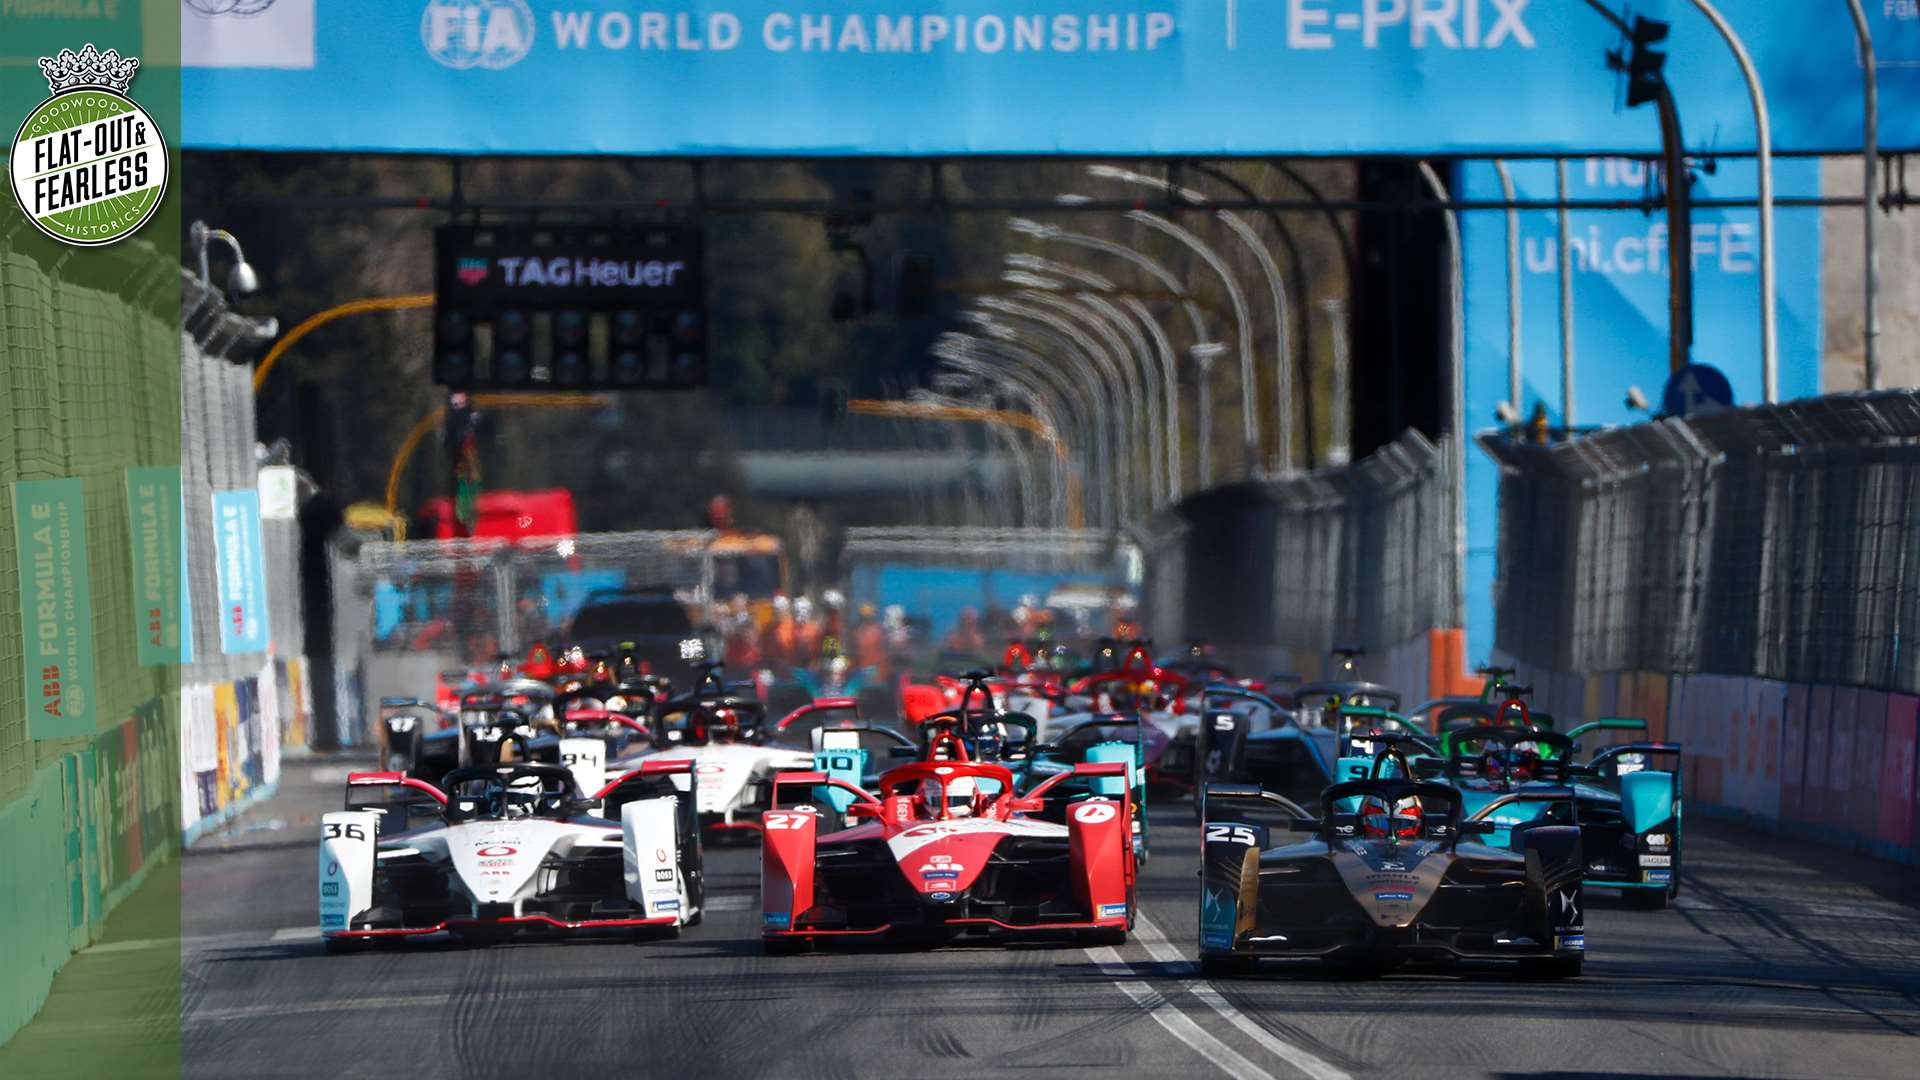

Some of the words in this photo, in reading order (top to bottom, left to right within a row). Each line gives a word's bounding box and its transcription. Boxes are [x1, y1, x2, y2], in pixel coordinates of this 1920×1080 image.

[552, 11, 742, 51] WORLD
[763, 11, 1176, 53] CHAMPIONSHIP
[1287, 0, 1536, 49] E-PRIX
[31, 502, 51, 519] E
[58, 502, 77, 621] CHAMPIONSHIP
[33, 527, 60, 656] FORMULA
[67, 627, 79, 680] WORLD
[42, 665, 64, 717] ABB
[1214, 715, 1235, 731] 5
[816, 756, 853, 771] 10
[323, 822, 366, 842] 36
[765, 813, 811, 830] 27
[1206, 825, 1256, 846] 25
